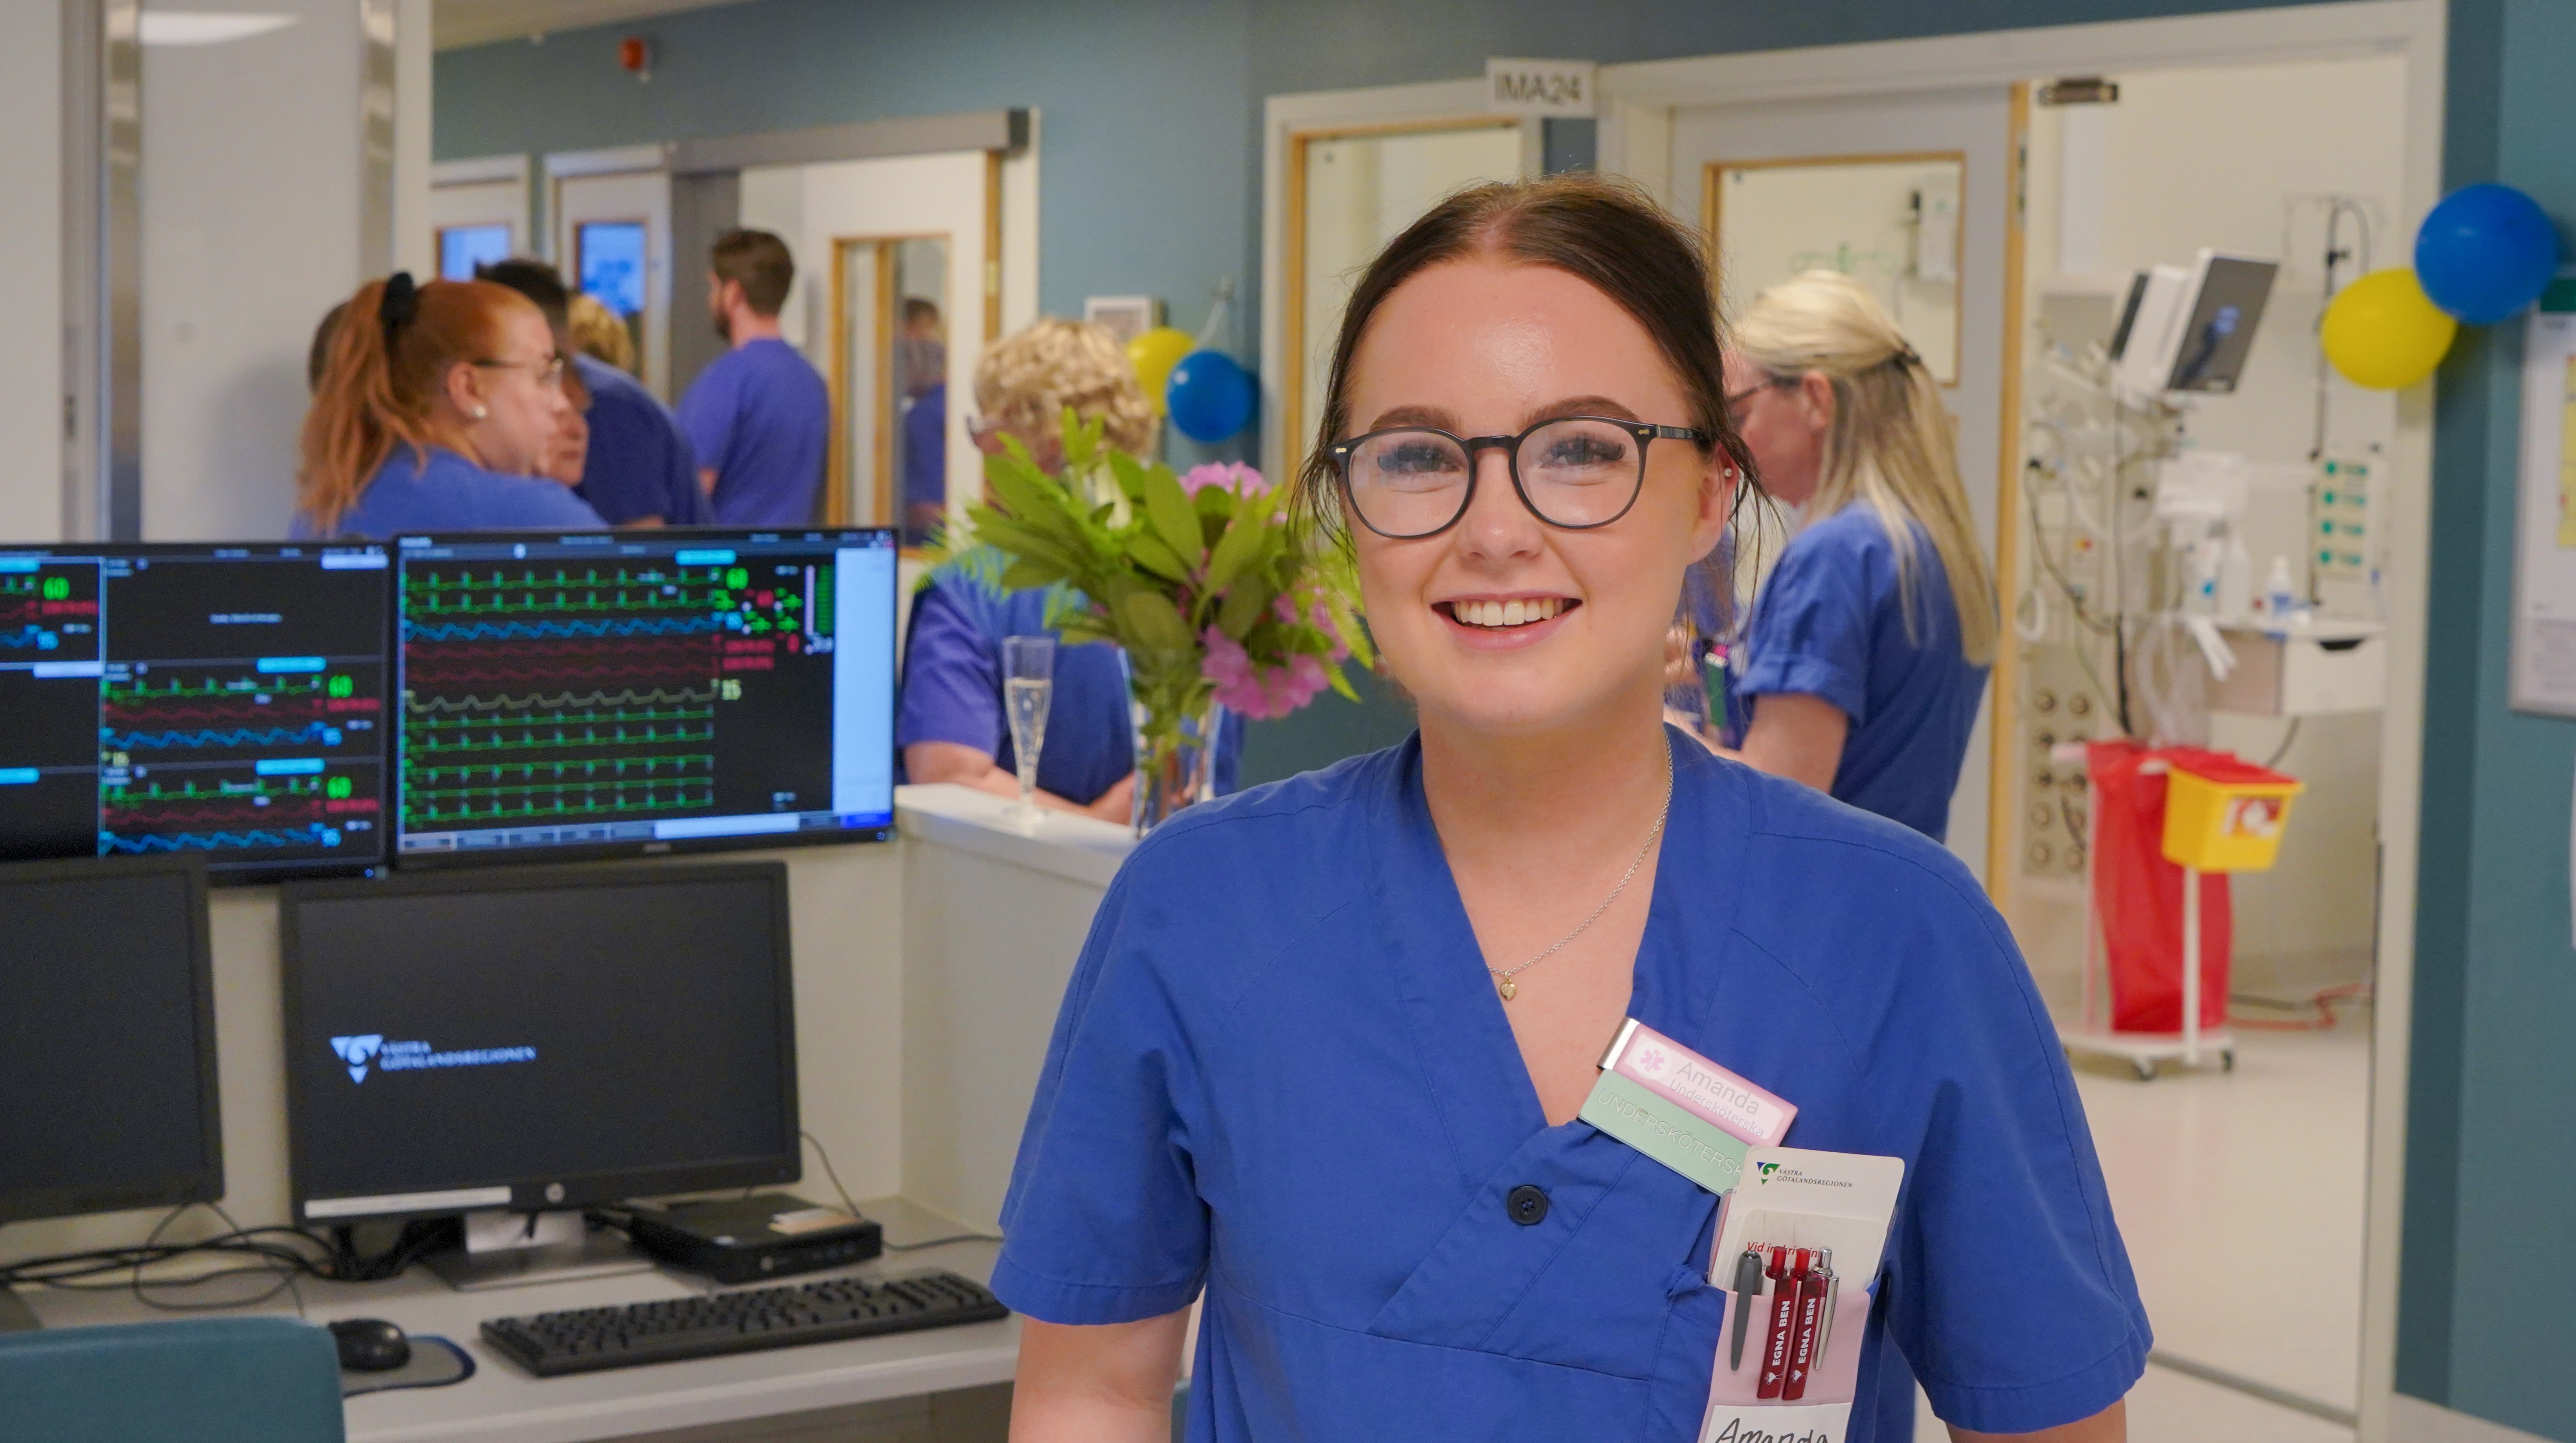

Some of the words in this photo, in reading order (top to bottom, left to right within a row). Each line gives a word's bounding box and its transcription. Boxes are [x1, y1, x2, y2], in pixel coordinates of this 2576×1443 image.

[1670, 1079, 1764, 1137] Undersköterska
[1677, 1062, 1759, 1116] Amanda
[1598, 1088, 1743, 1176] UNDERSKÖTERSK
[1777, 1175, 1853, 1187] GÖTALANDSREGIONEN
[1747, 1241, 1765, 1252] Vid
[1772, 1330, 1786, 1366] EGNA
[1779, 1300, 1790, 1327] BEN
[1804, 1298, 1816, 1325] BEN
[1798, 1327, 1811, 1364] EGNA
